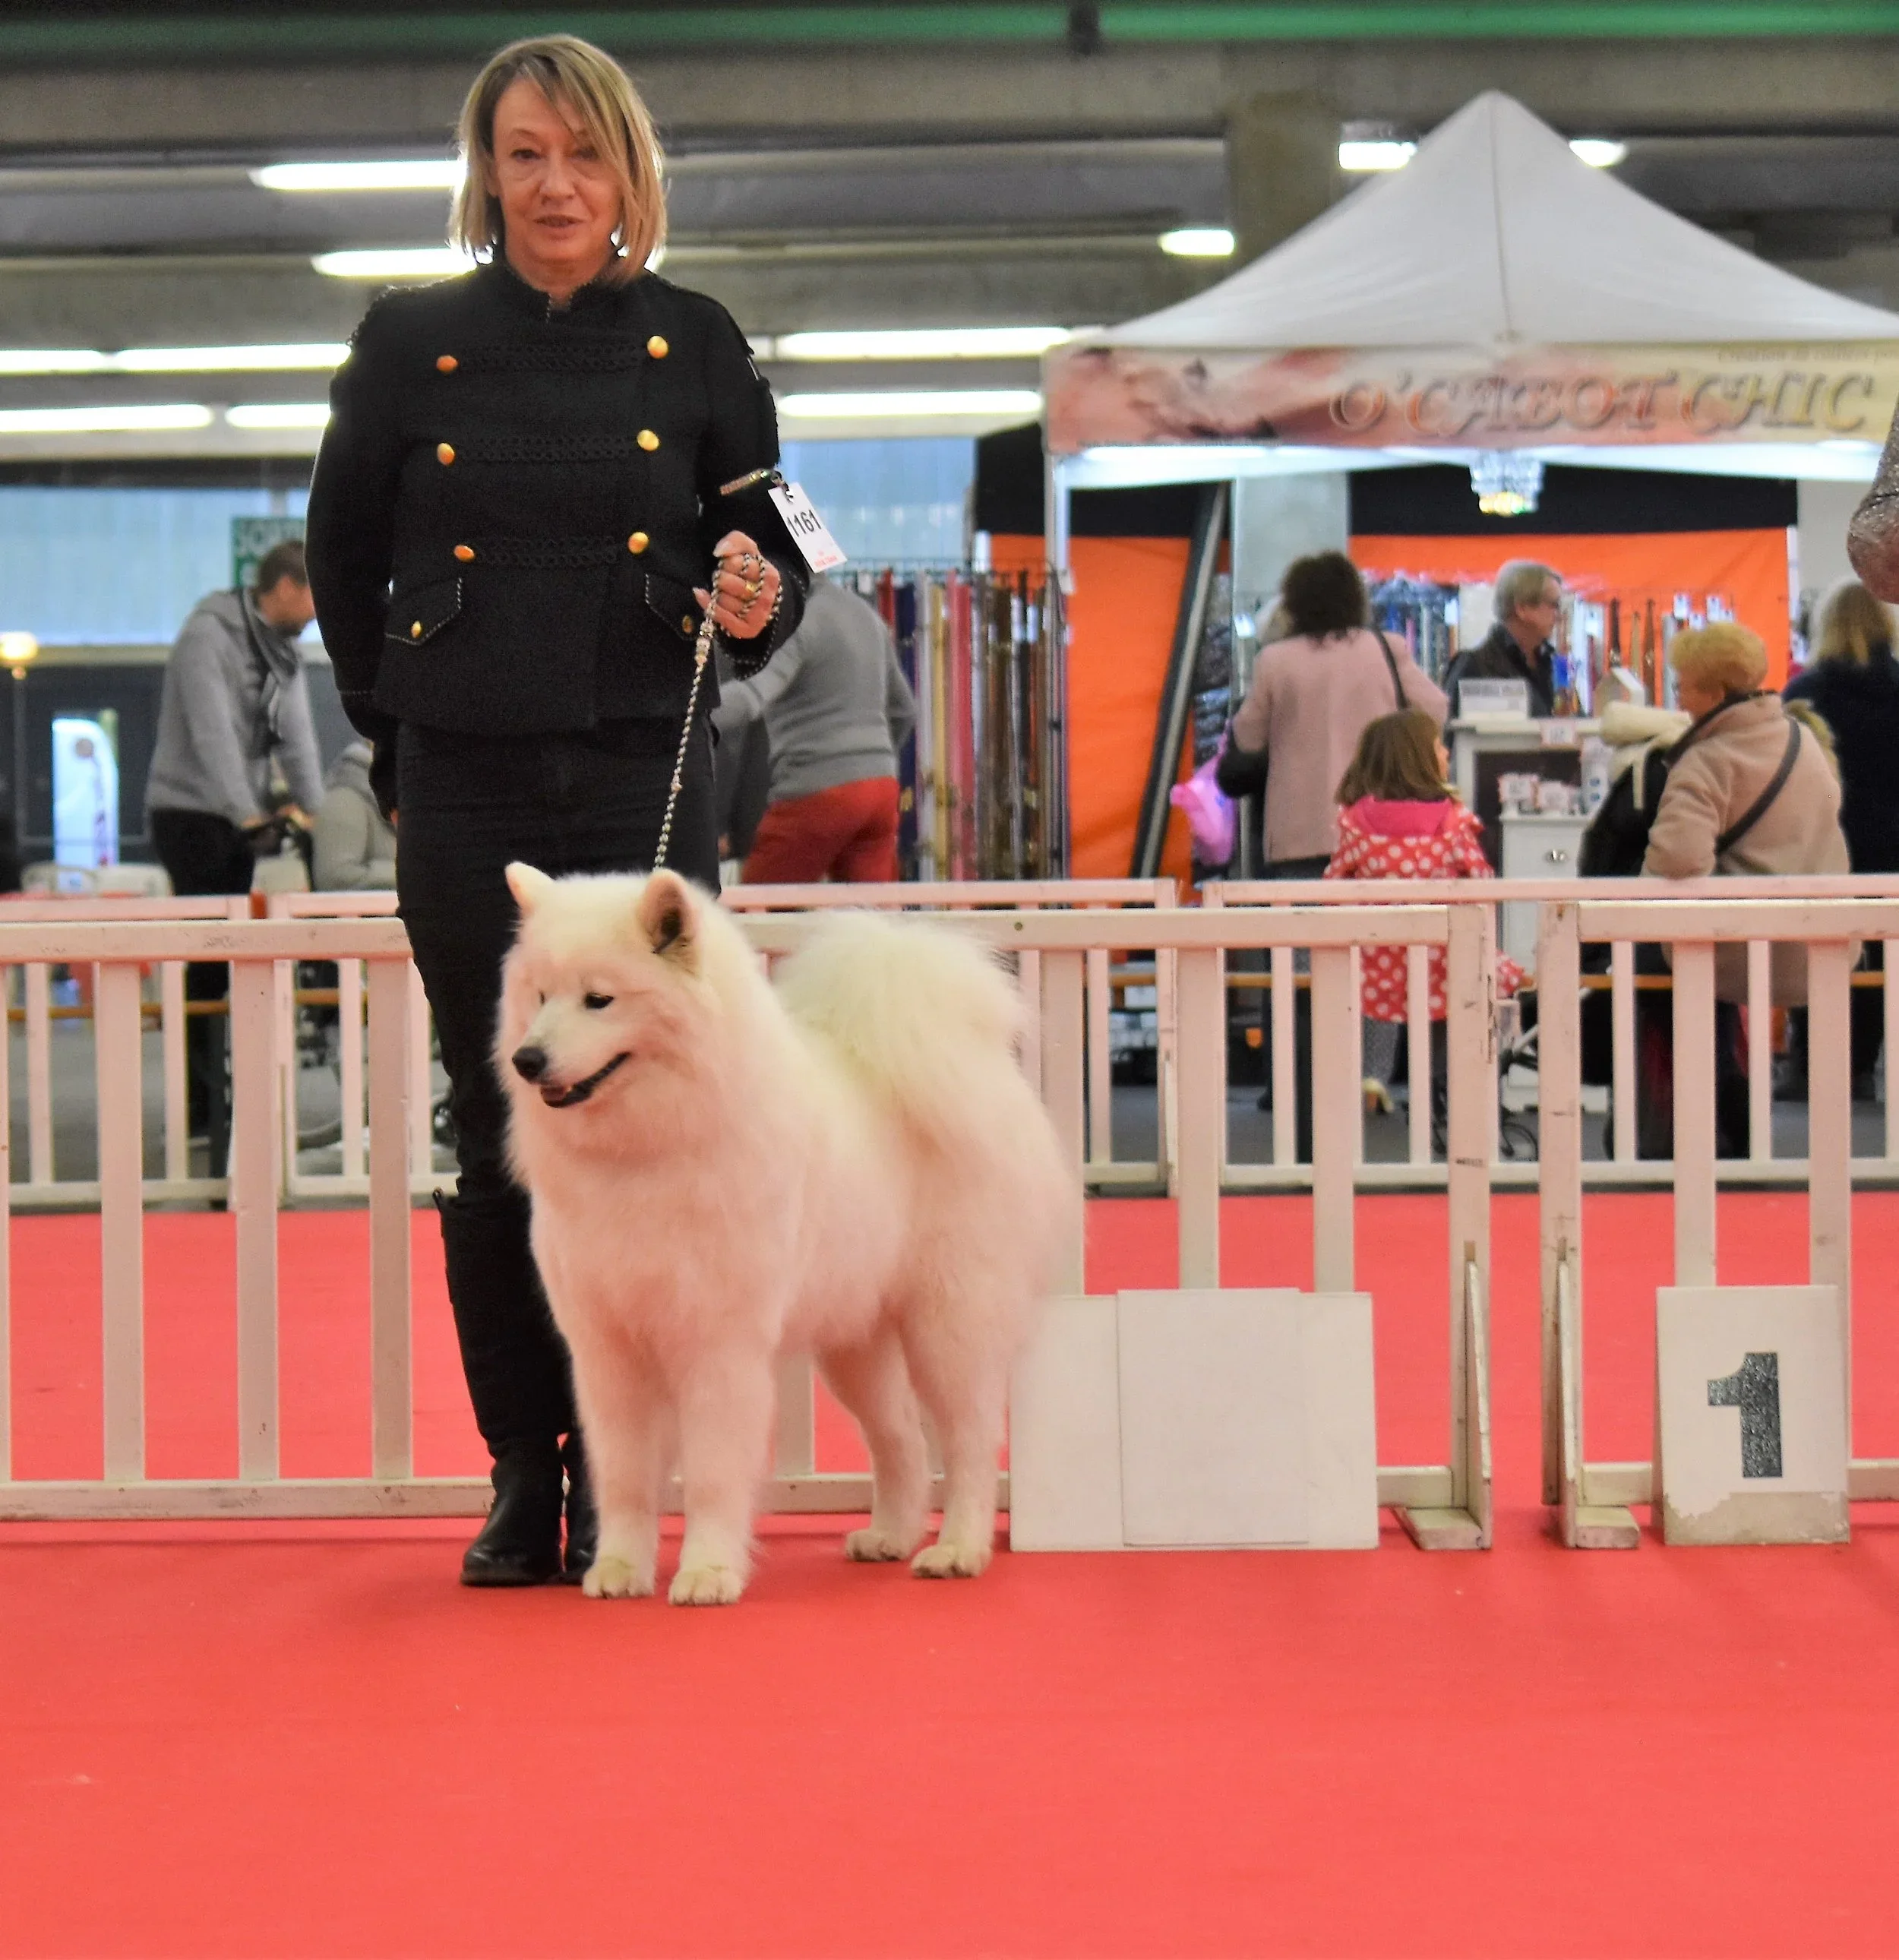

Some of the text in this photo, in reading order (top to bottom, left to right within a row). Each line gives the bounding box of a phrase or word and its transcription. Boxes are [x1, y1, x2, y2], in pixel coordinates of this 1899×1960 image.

[1679, 371, 1874, 435] CHIC
[786, 510, 822, 538] 1161
[1708, 1351, 1783, 1478] 1
